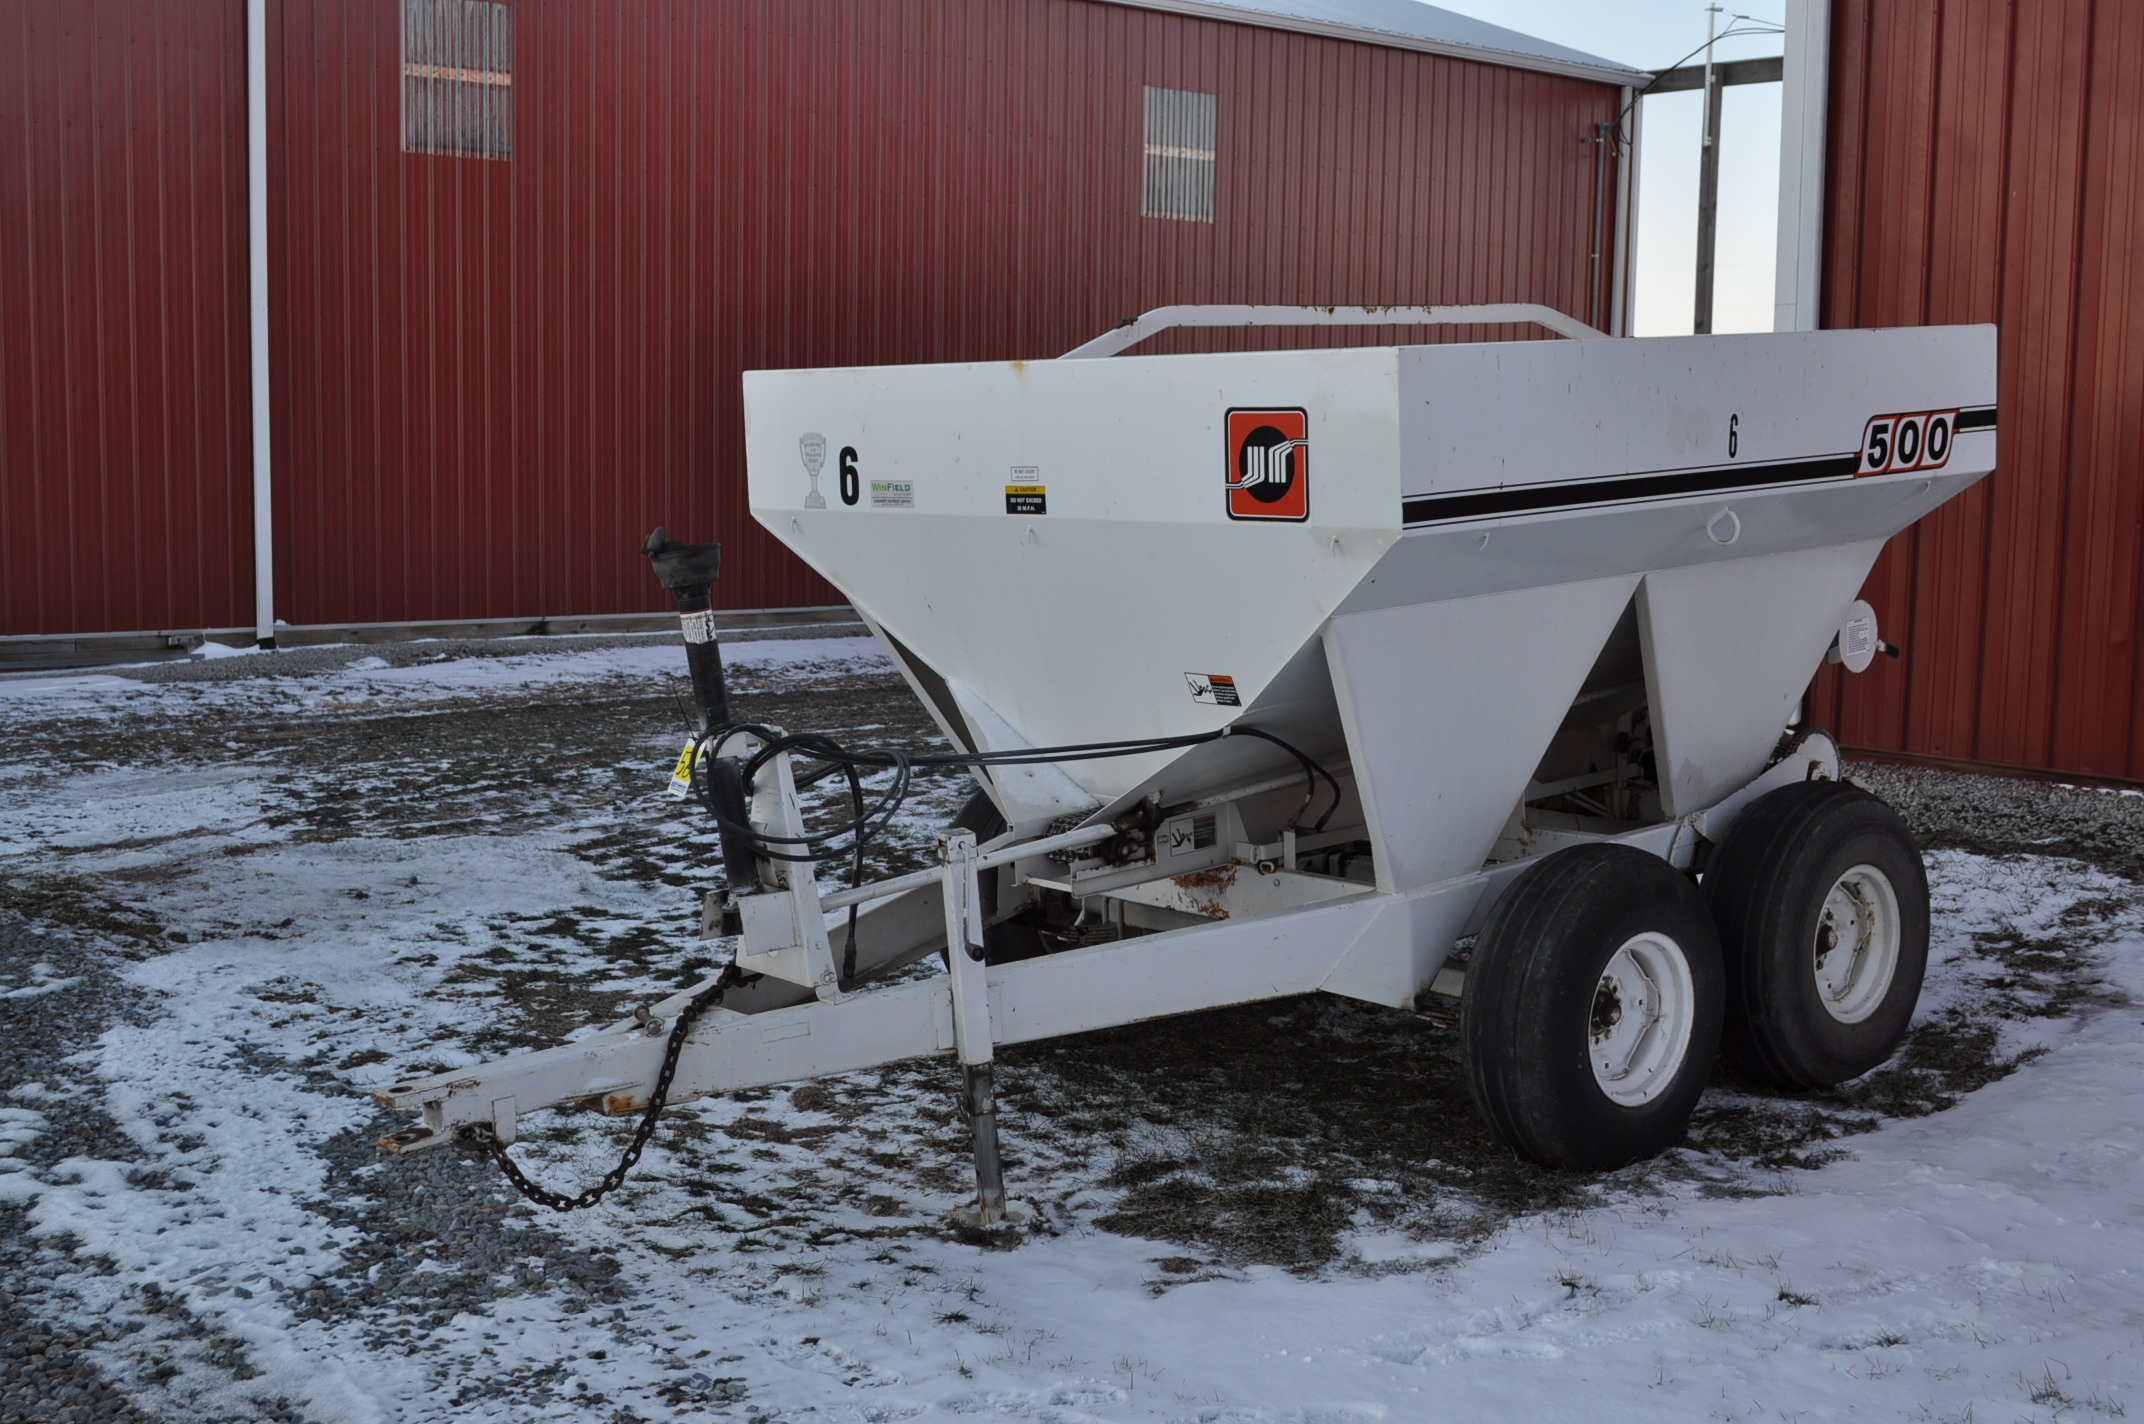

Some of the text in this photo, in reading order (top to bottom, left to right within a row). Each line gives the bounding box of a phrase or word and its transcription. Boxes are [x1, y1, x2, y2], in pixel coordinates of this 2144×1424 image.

[1728, 413, 1738, 459] 6
[1867, 417, 1948, 468] 500
[839, 446, 860, 506] 6
